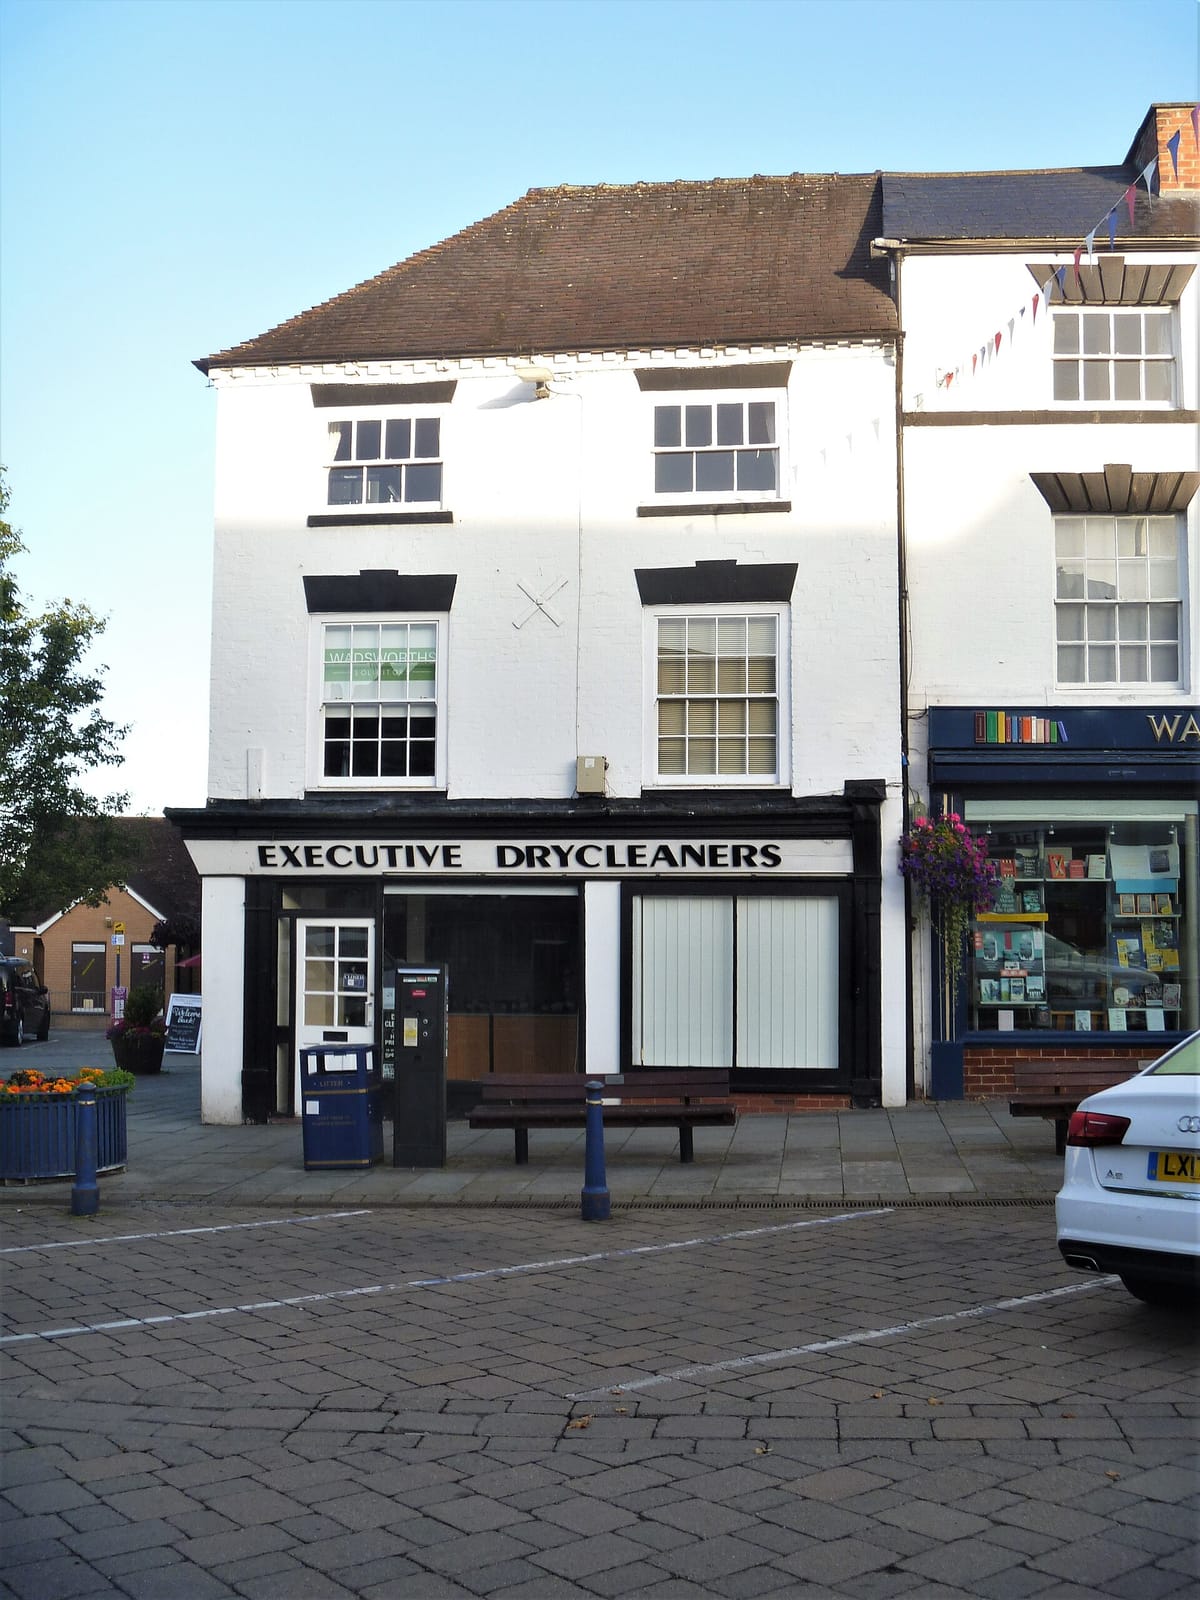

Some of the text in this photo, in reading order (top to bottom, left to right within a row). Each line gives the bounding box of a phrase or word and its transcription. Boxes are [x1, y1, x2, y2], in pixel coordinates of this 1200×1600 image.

[329, 652, 437, 663] WADSWORTHS
[257, 844, 782, 868] EXECUTIVE DRYCLEANERS
